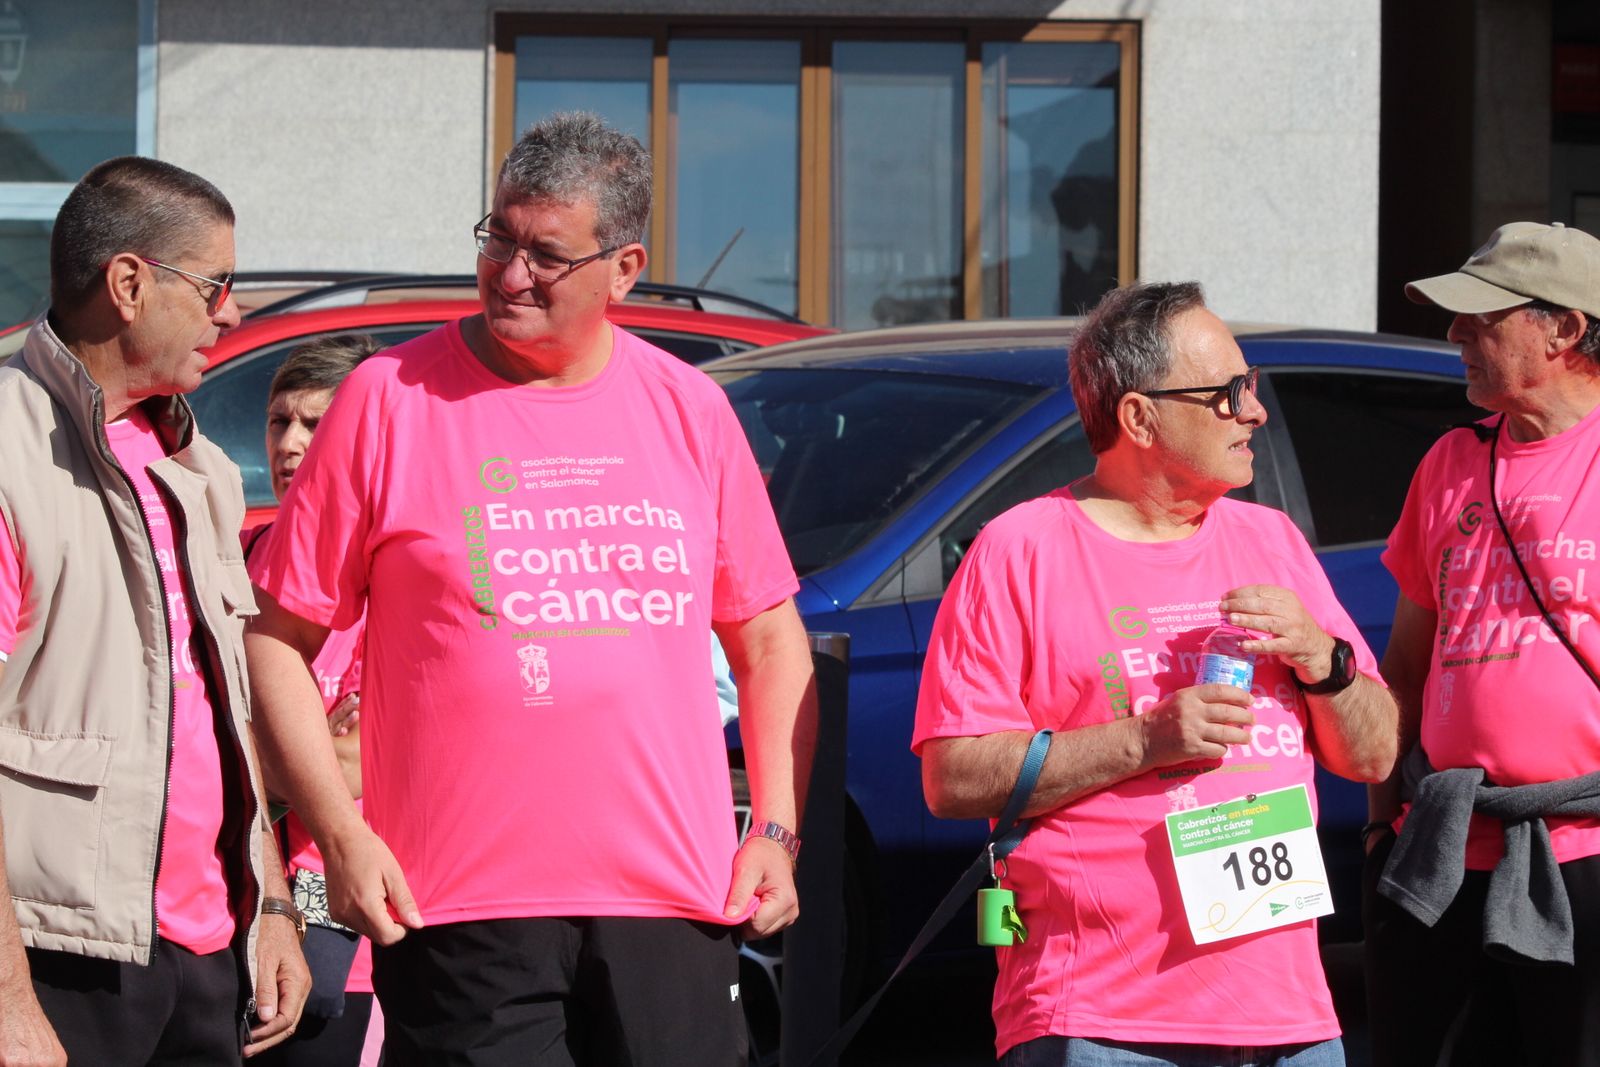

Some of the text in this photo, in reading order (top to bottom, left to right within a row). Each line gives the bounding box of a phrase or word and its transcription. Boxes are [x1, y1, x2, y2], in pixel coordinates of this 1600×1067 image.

[522, 468, 557, 479] contra
[559, 466, 569, 476] el
[578, 456, 624, 467] española
[525, 478, 600, 490] en Salamanca
[485, 499, 687, 532] En marcha
[492, 538, 691, 576] contra el
[1490, 531, 1596, 569] marcha
[461, 504, 499, 631] CABRERIZOS
[1549, 568, 1590, 603] el
[501, 578, 694, 627] cáncer
[1151, 614, 1182, 625] contra
[1183, 612, 1192, 622] el
[1155, 626, 1168, 634] en
[1121, 648, 1169, 679] En
[1177, 814, 1227, 831] Cabrerizos
[1180, 828, 1210, 841] contra
[1212, 824, 1222, 834] el
[1222, 841, 1294, 892] 188
